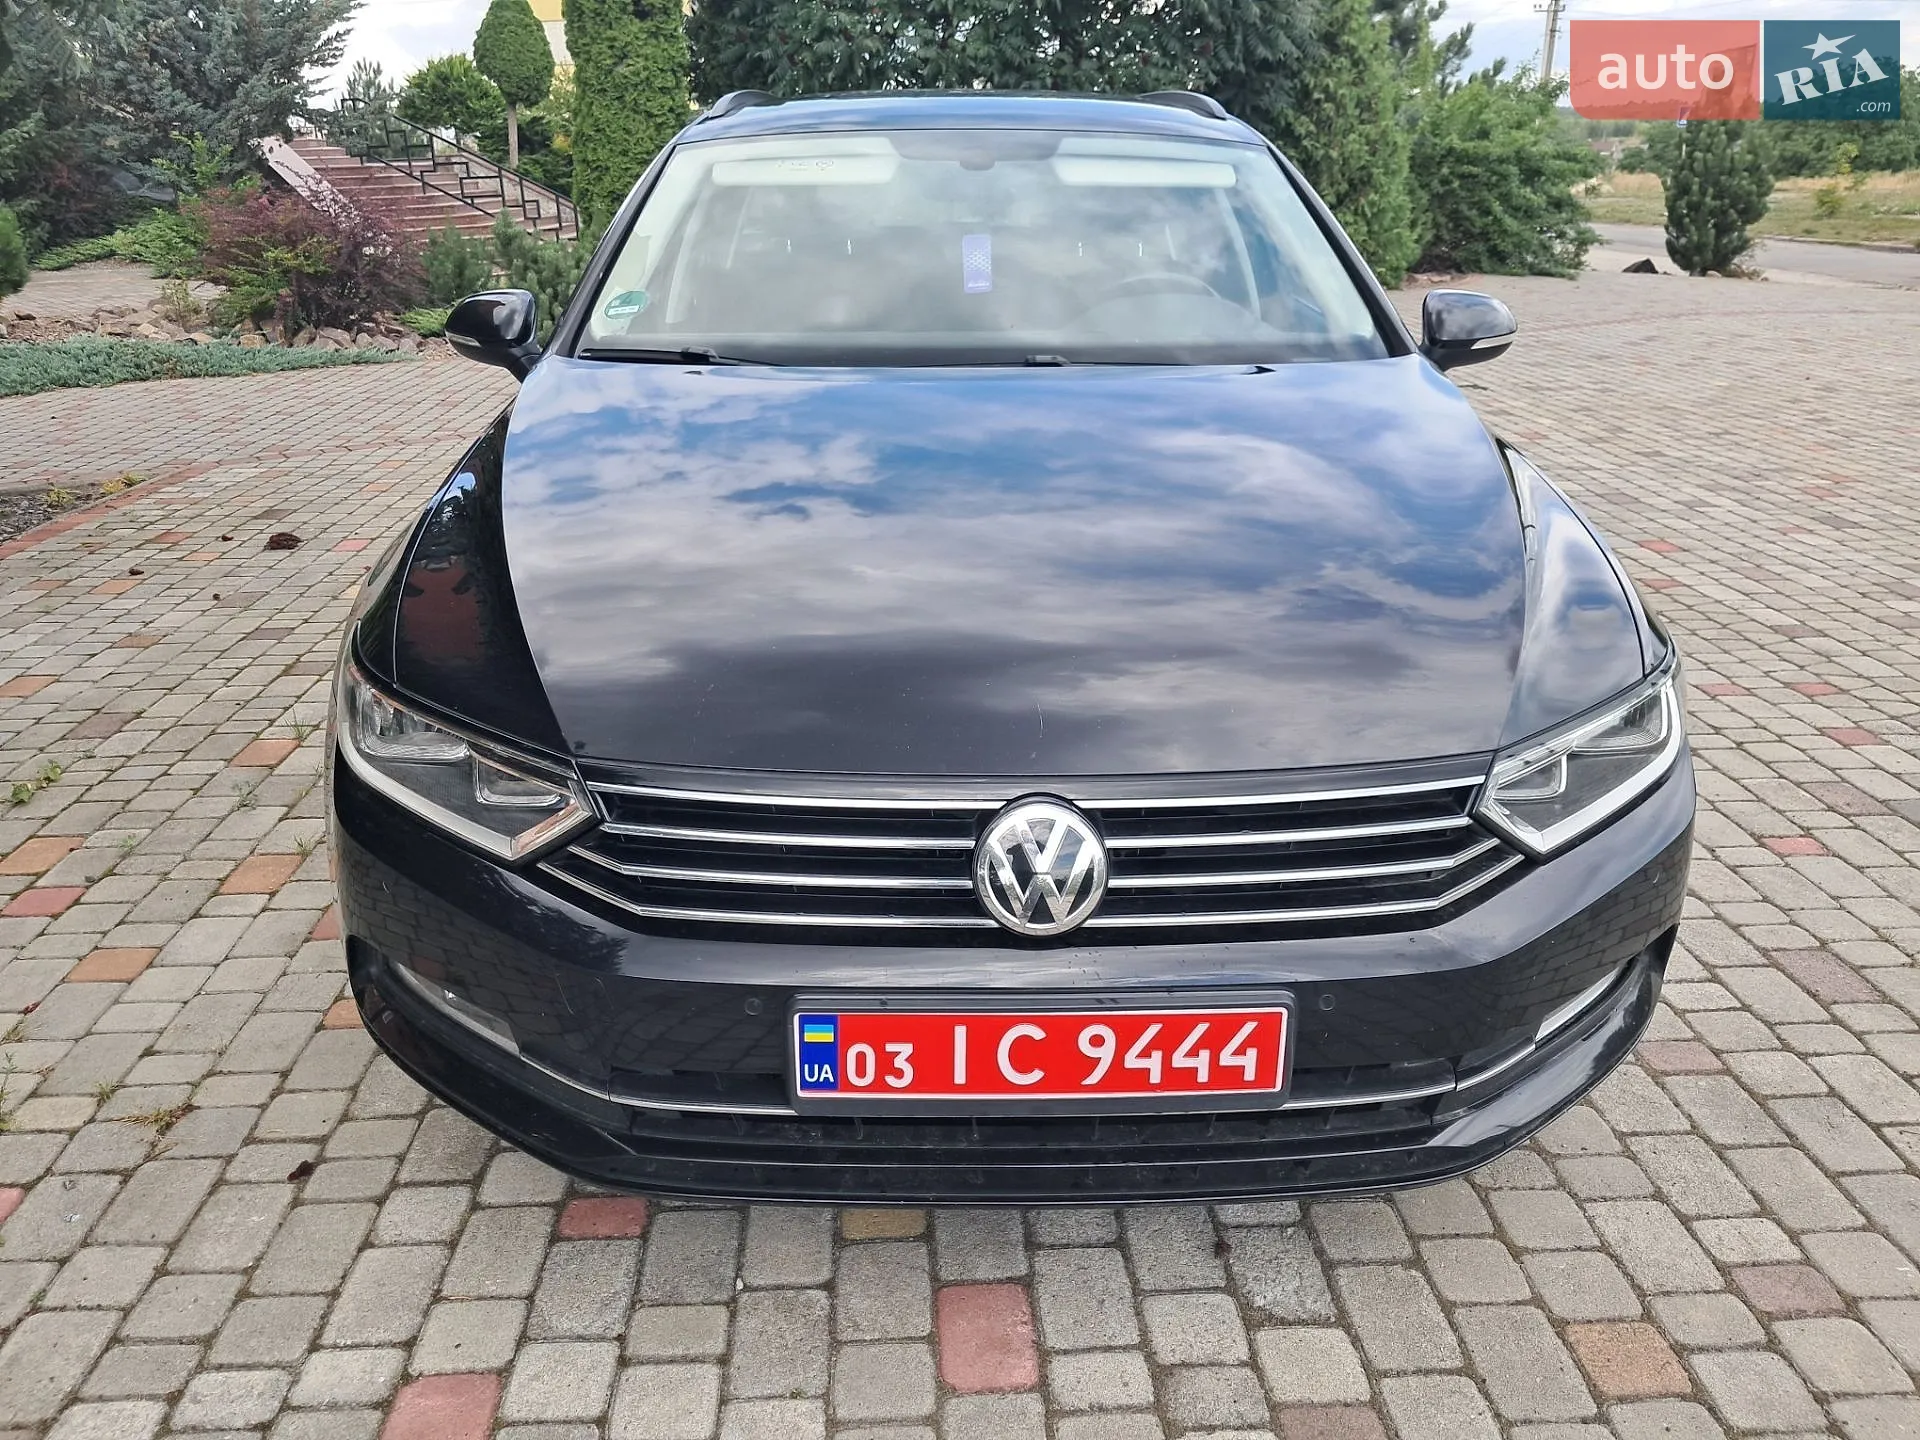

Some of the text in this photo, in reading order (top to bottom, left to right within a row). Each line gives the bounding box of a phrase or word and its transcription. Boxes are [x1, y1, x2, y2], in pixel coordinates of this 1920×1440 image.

[804, 1063, 835, 1083] UA
[846, 1043, 914, 1088] 03
[1077, 1021, 1259, 1086] 9444
